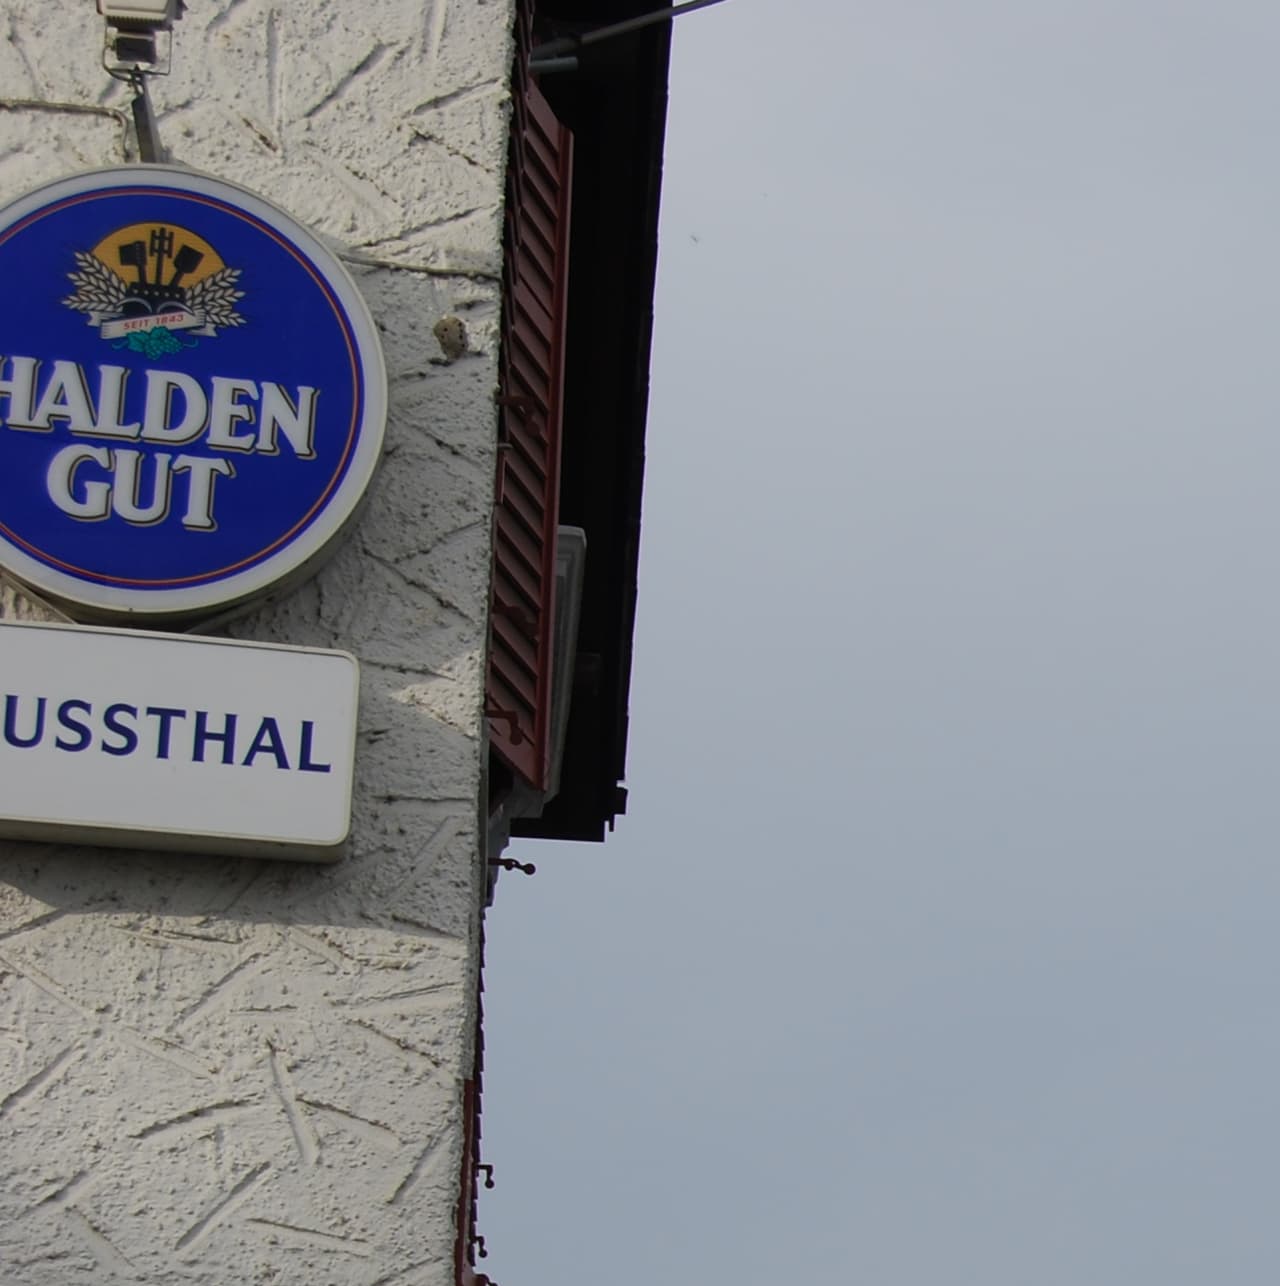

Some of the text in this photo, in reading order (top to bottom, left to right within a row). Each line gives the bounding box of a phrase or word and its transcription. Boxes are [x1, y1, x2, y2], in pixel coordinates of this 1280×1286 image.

[123, 314, 185, 330] SEIT 1843
[0, 355, 318, 457] HALDEN
[47, 445, 233, 530] GUT
[4, 694, 331, 773] USSTHAL
